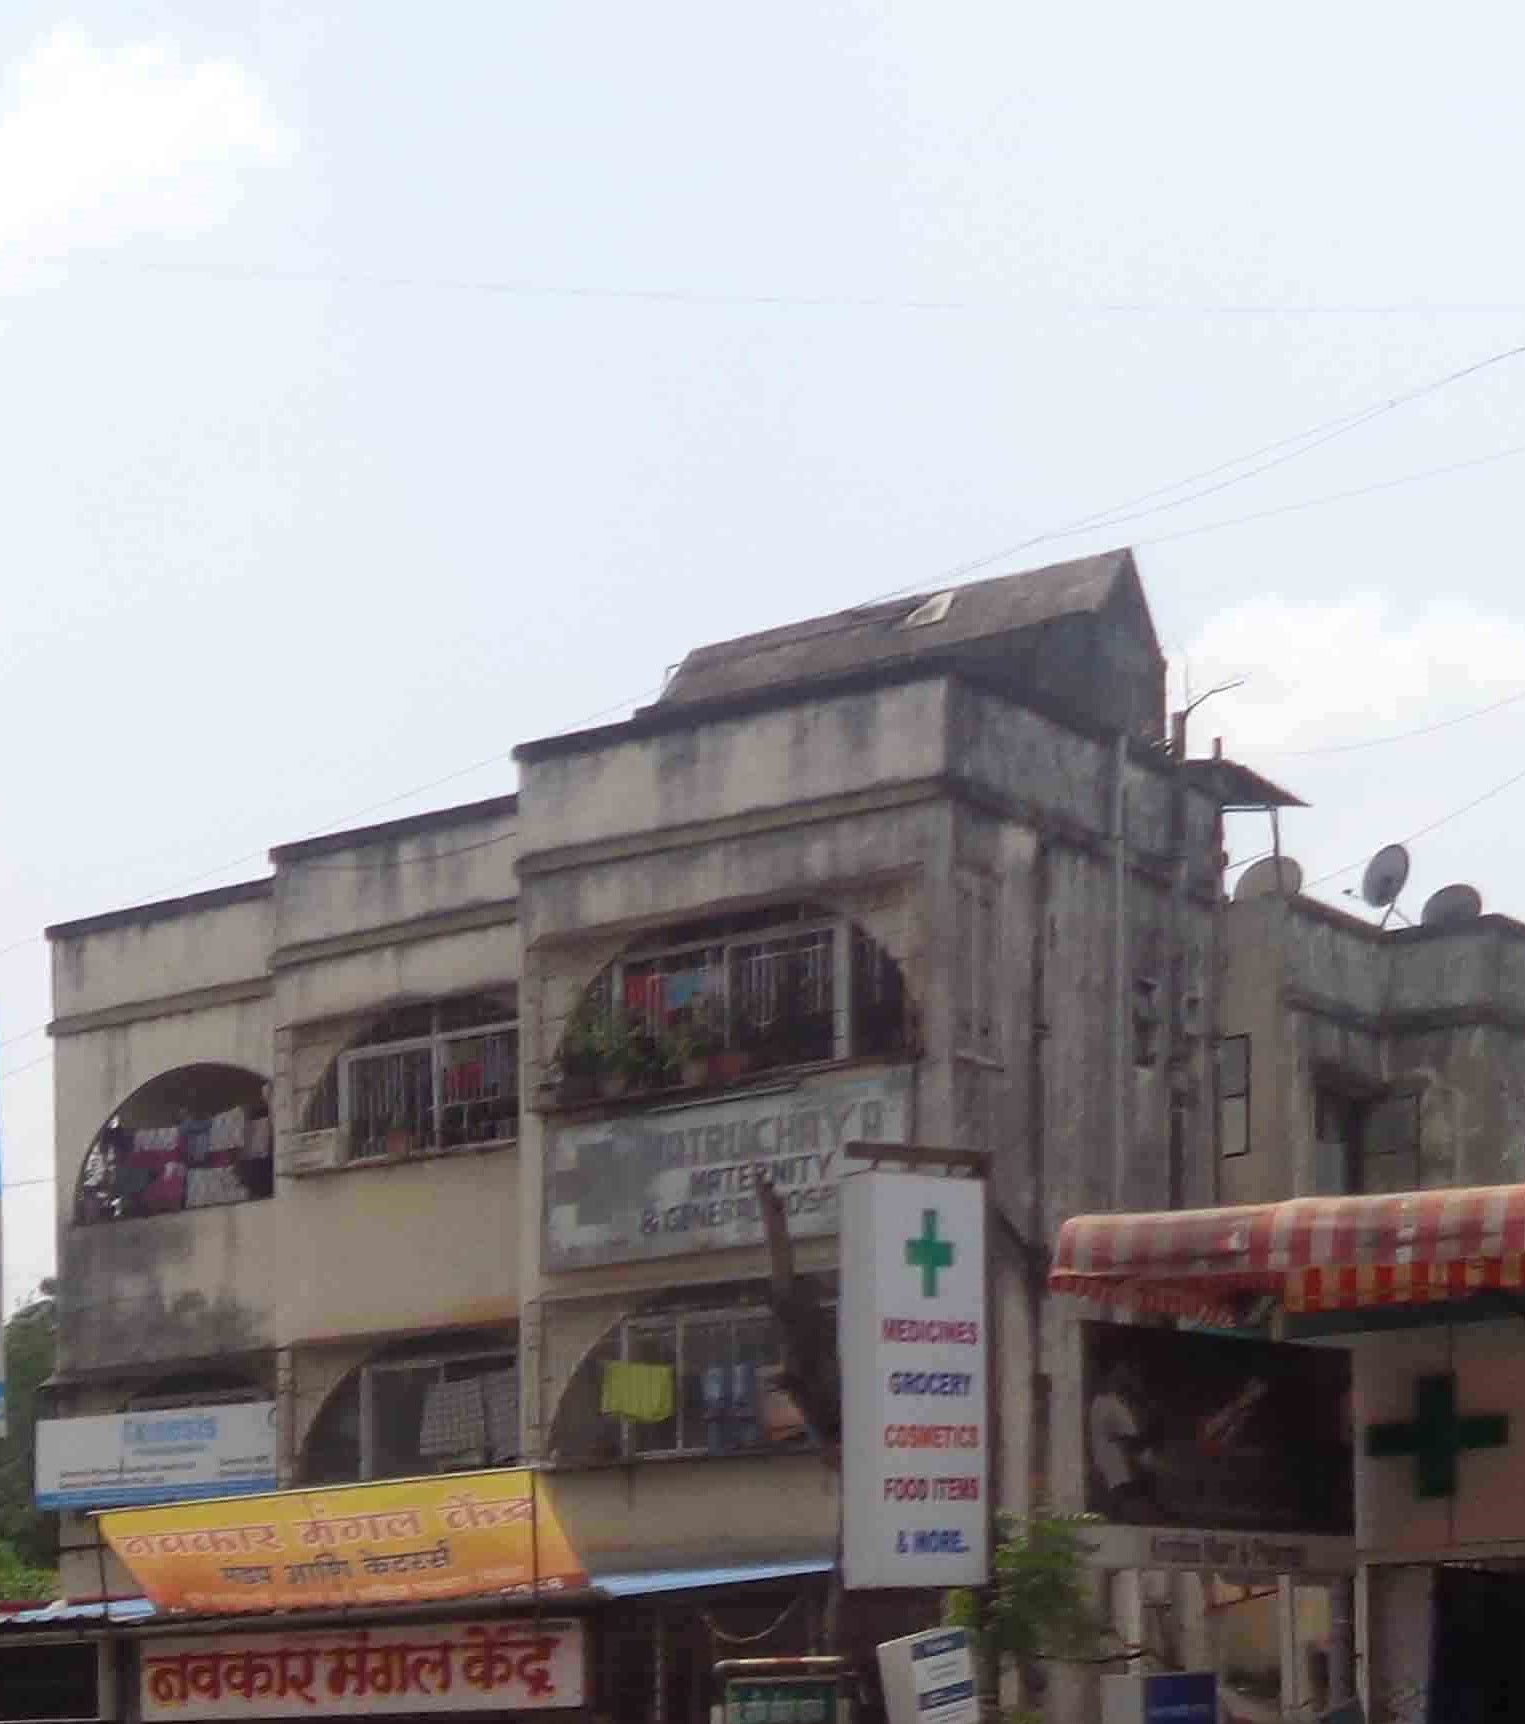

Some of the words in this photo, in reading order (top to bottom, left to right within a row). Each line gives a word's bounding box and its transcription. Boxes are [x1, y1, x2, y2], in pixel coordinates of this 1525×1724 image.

[882, 1318, 978, 1345] MEDICINES
[890, 1371, 972, 1397] GROCERY
[883, 1424, 979, 1449] COSMETICS
[883, 1476, 929, 1502] FOOD
[931, 1476, 979, 1502] ITEMS
[146, 1648, 321, 1705] नवकार
[322, 1631, 451, 1698] मंगल
[453, 1625, 562, 1697] केंद्र
